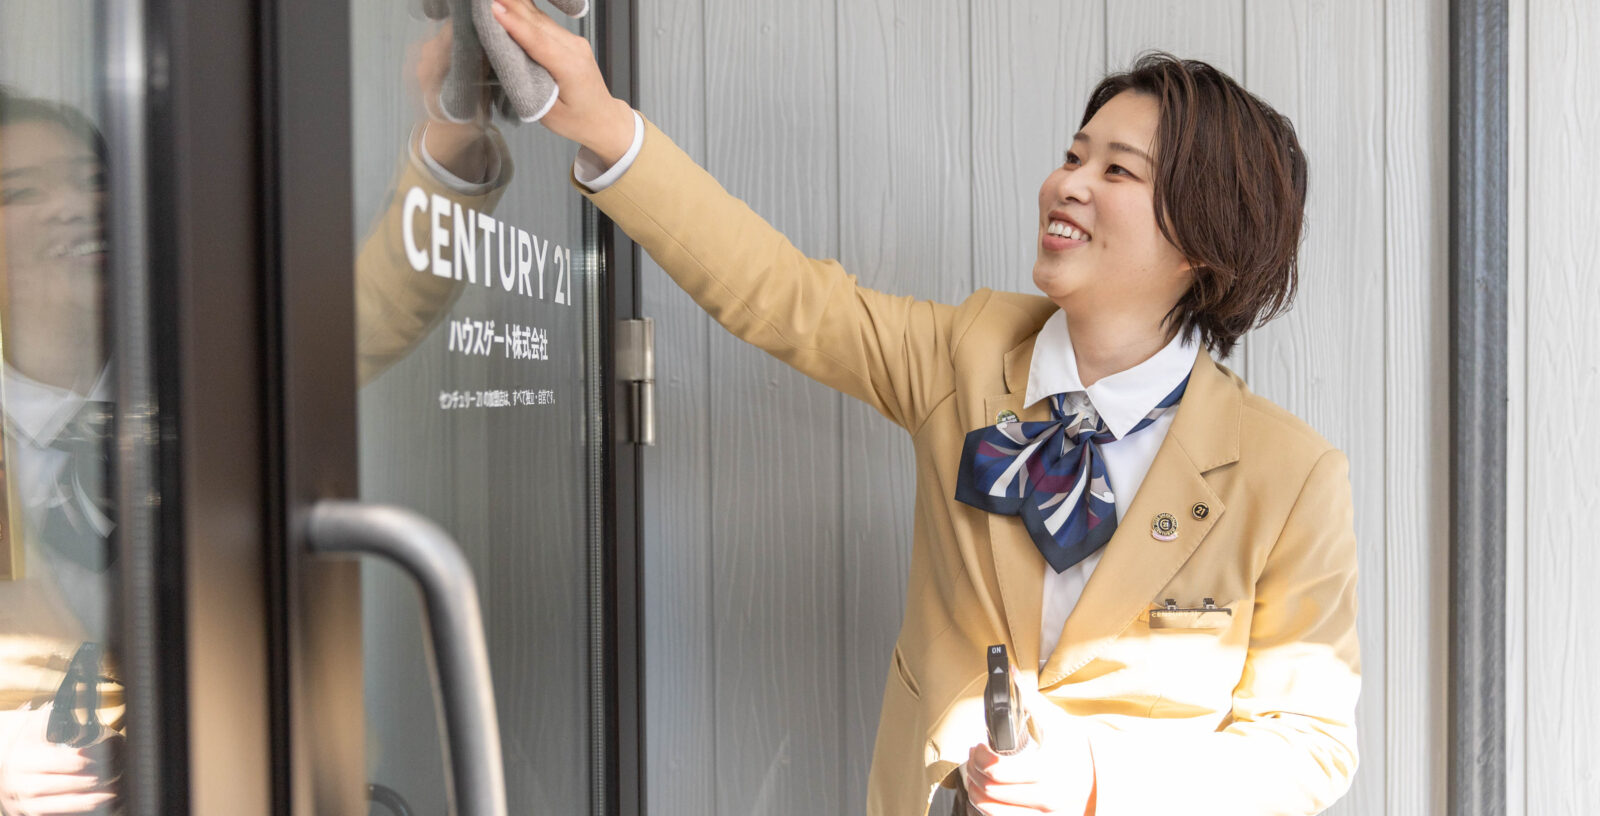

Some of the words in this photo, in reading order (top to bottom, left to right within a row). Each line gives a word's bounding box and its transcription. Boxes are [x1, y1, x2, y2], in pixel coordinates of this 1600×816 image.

[403, 186, 548, 299] CENTURY
[554, 245, 571, 306] 21
[449, 317, 549, 360] ハウスゲート株式会社
[991, 646, 1002, 654] ON
